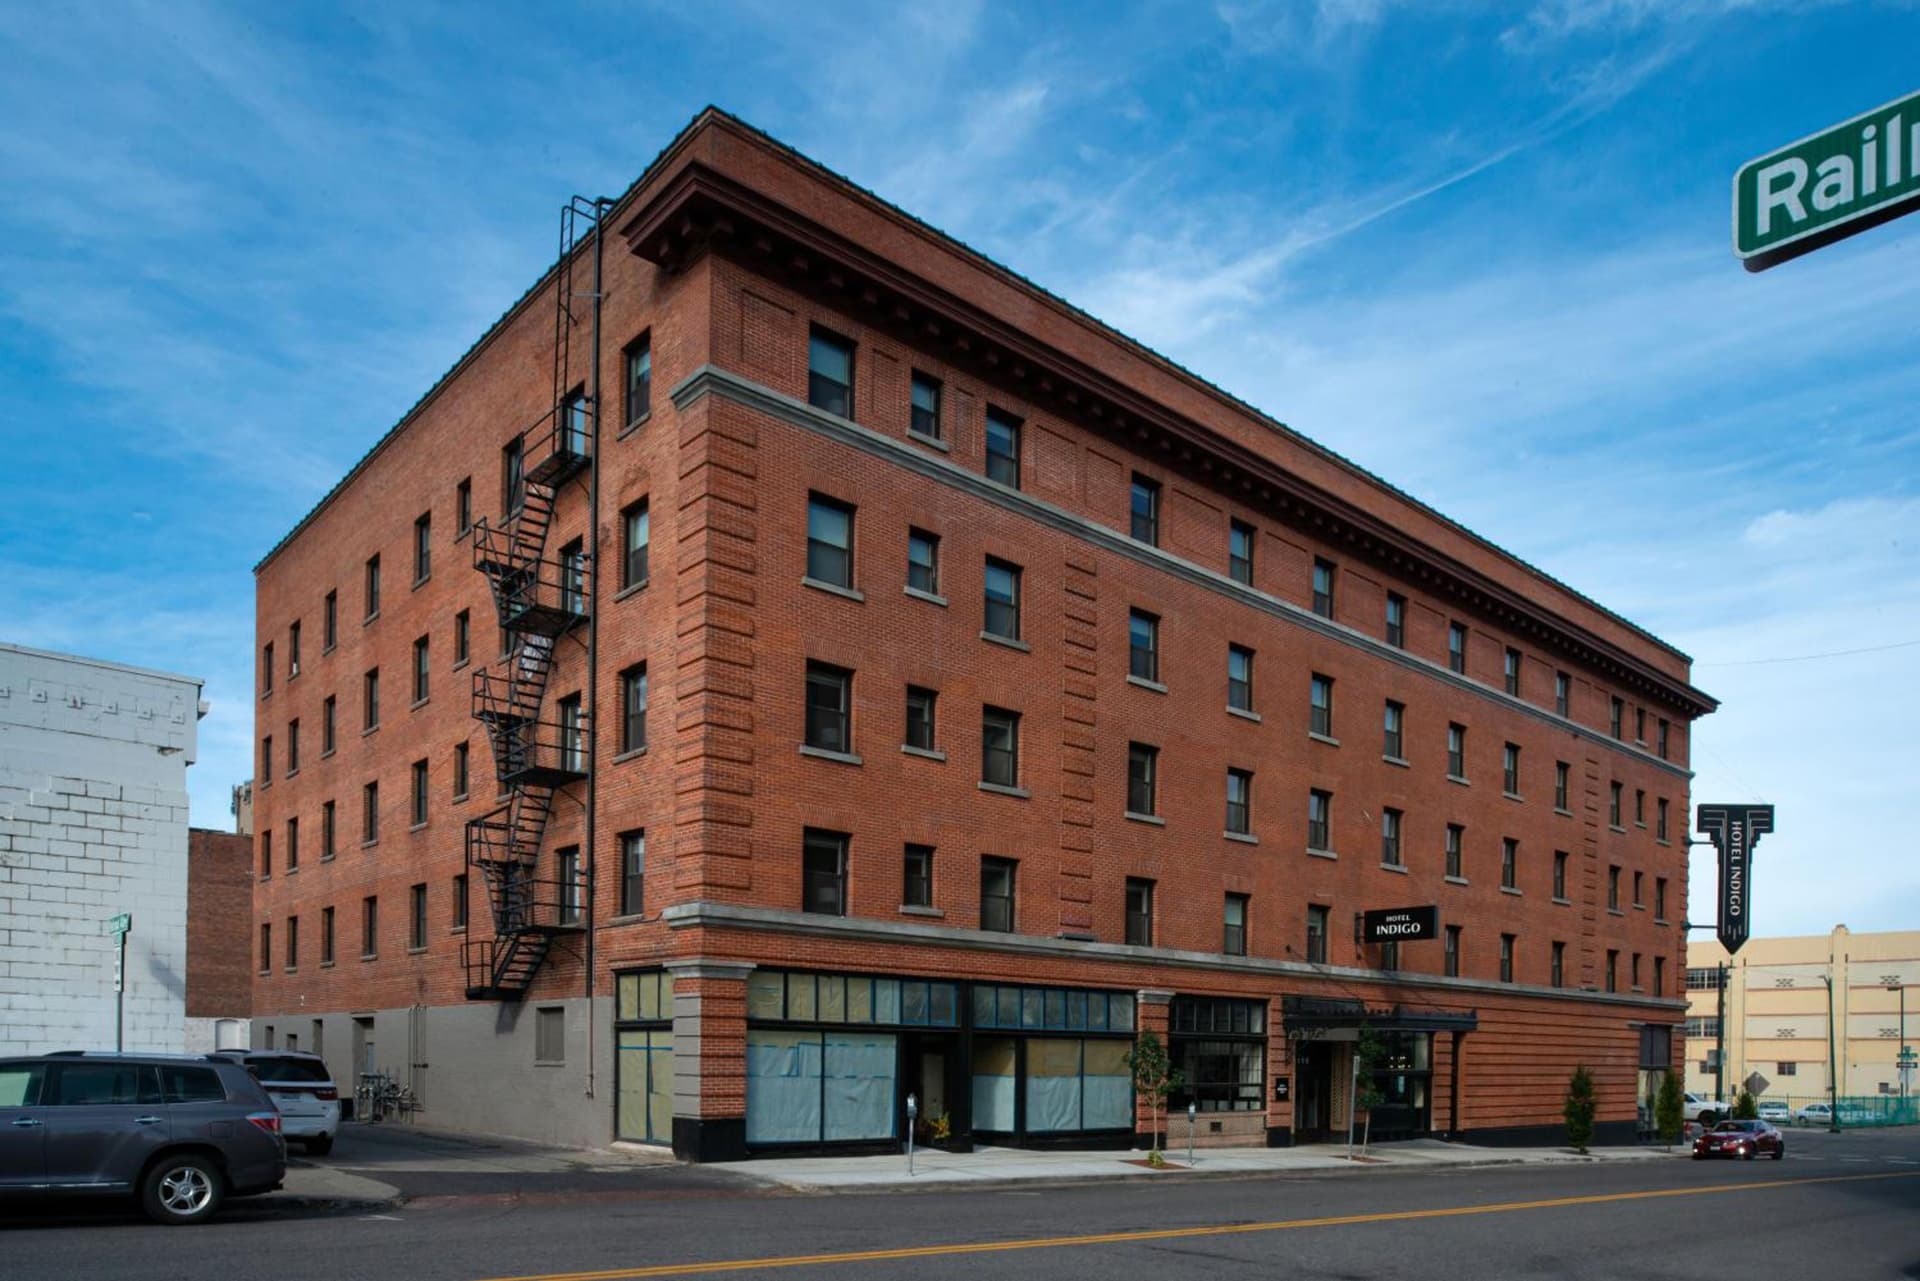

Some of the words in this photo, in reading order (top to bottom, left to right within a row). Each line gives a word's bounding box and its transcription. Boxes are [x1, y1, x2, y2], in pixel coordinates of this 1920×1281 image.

[1731, 821, 1743, 862] HOTEL
[1729, 866, 1742, 916] INDIGO
[1376, 922, 1421, 935] INDIGO
[1386, 914, 1411, 922] HOTEL
